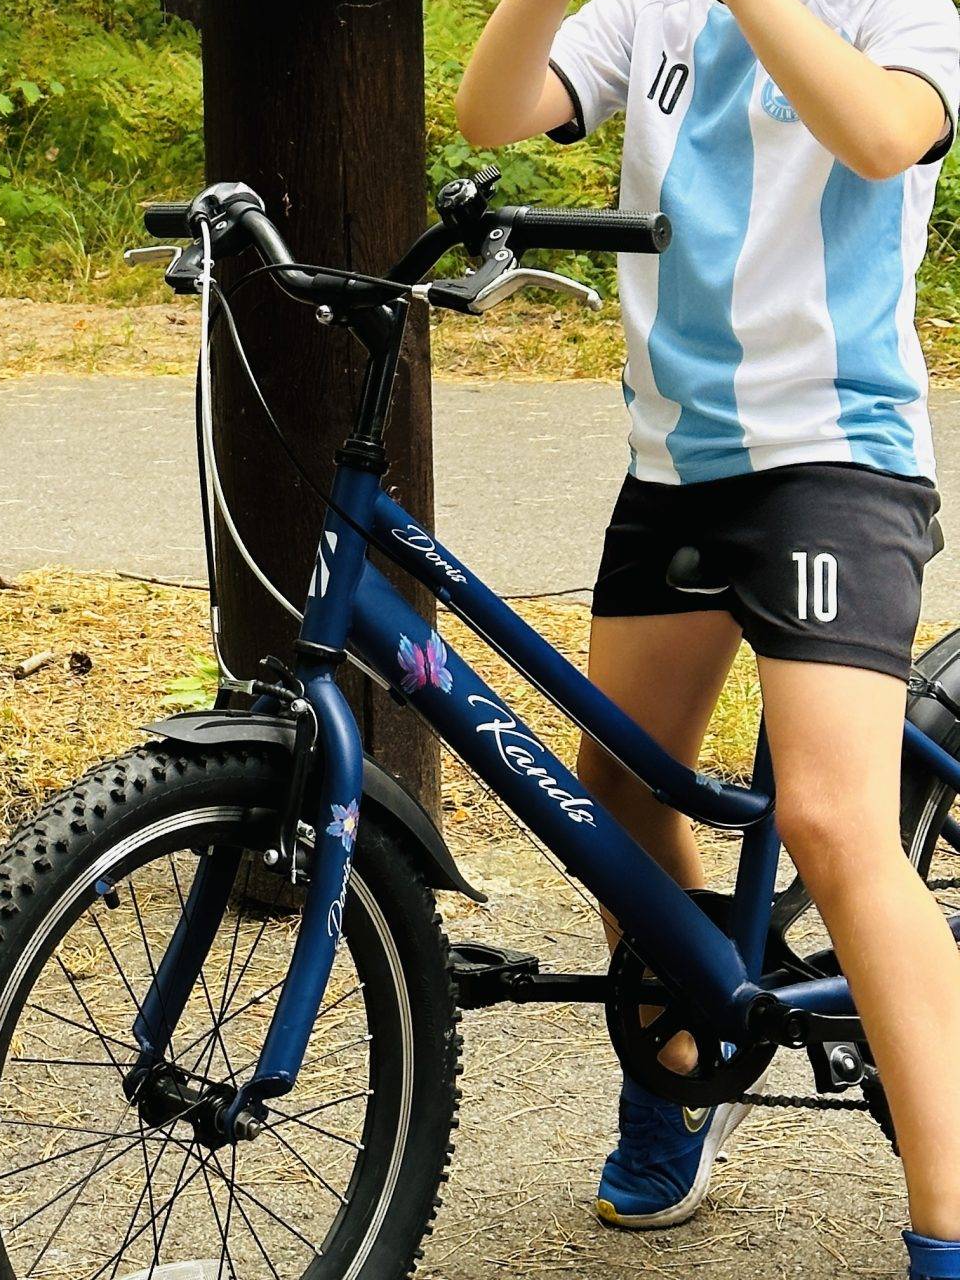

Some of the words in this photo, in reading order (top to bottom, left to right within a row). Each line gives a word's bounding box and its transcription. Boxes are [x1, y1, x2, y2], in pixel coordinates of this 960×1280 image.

[647, 51, 689, 117] 10
[391, 523, 469, 586] Doris
[792, 552, 838, 623] 10
[467, 694, 597, 828] Kands
